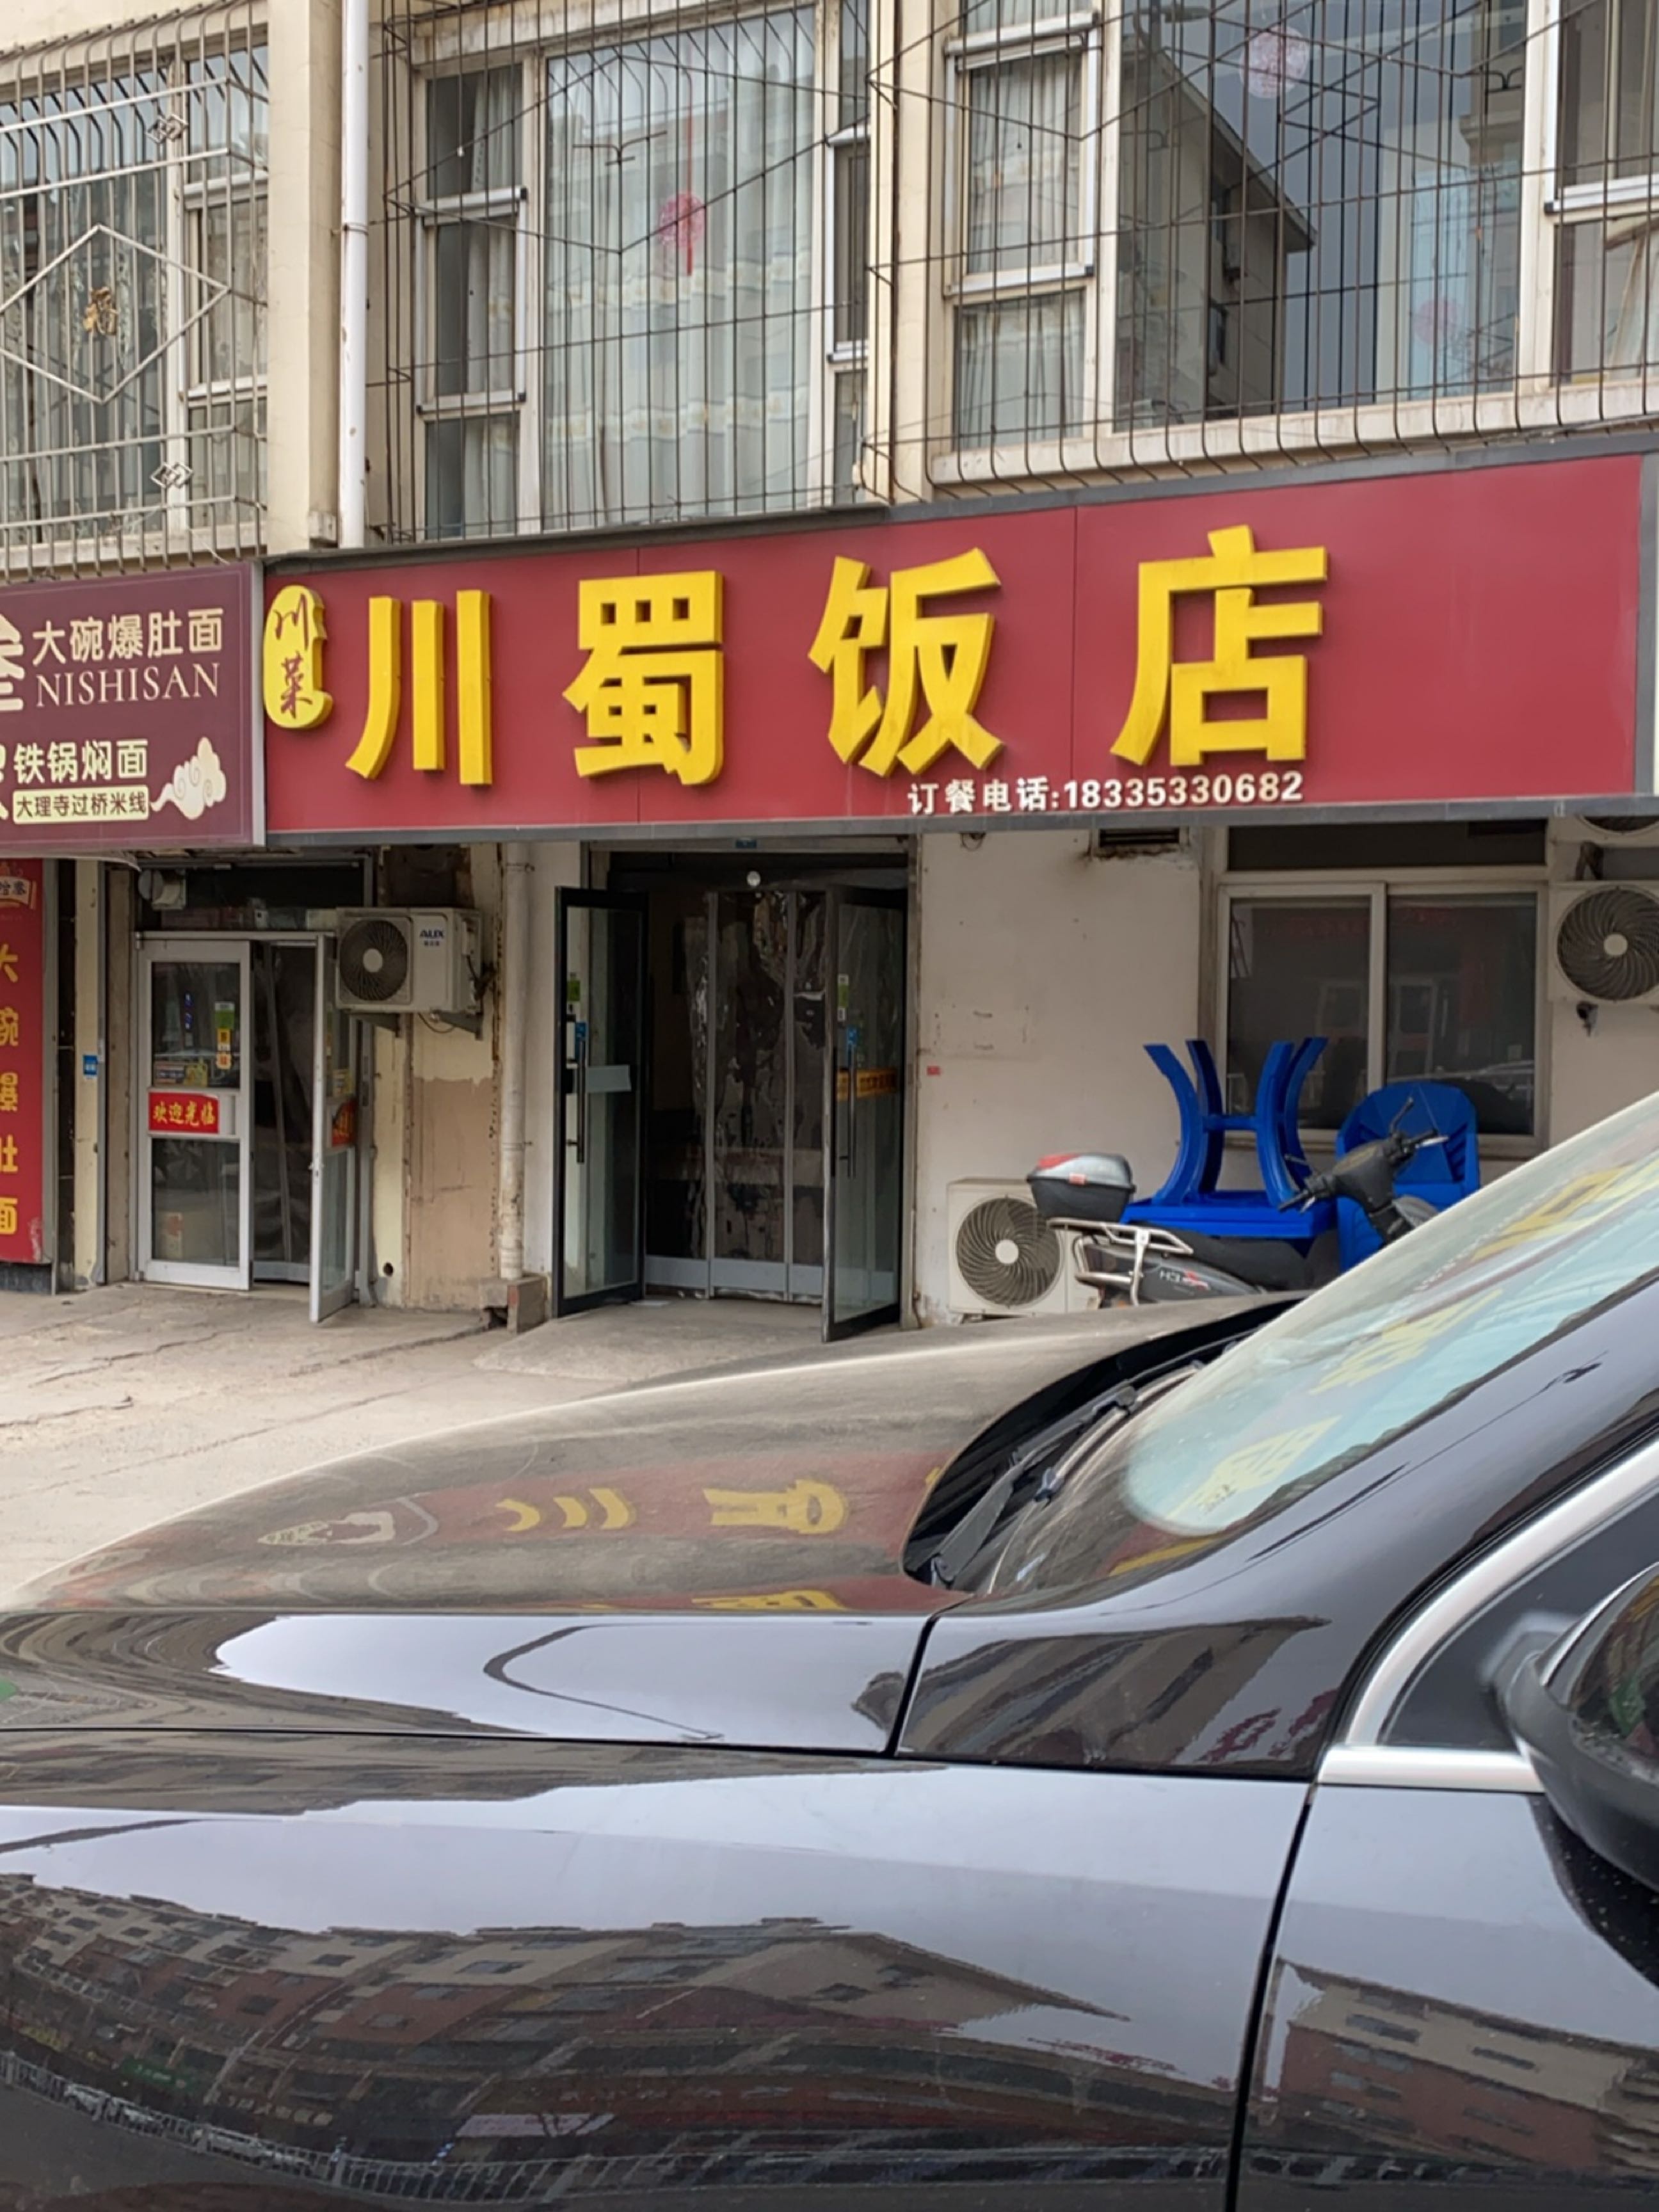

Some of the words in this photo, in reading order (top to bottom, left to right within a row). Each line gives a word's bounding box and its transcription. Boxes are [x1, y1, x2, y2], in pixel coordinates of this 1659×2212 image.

[31, 608, 224, 666] 大碗爆肚面
[272, 593, 314, 719] 川菜
[347, 525, 1327, 786] 川蜀饭店
[36, 662, 220, 708] NISHISAN
[13, 739, 149, 784] 铁锅焖面
[16, 794, 147, 819] 大理寺过桥米线
